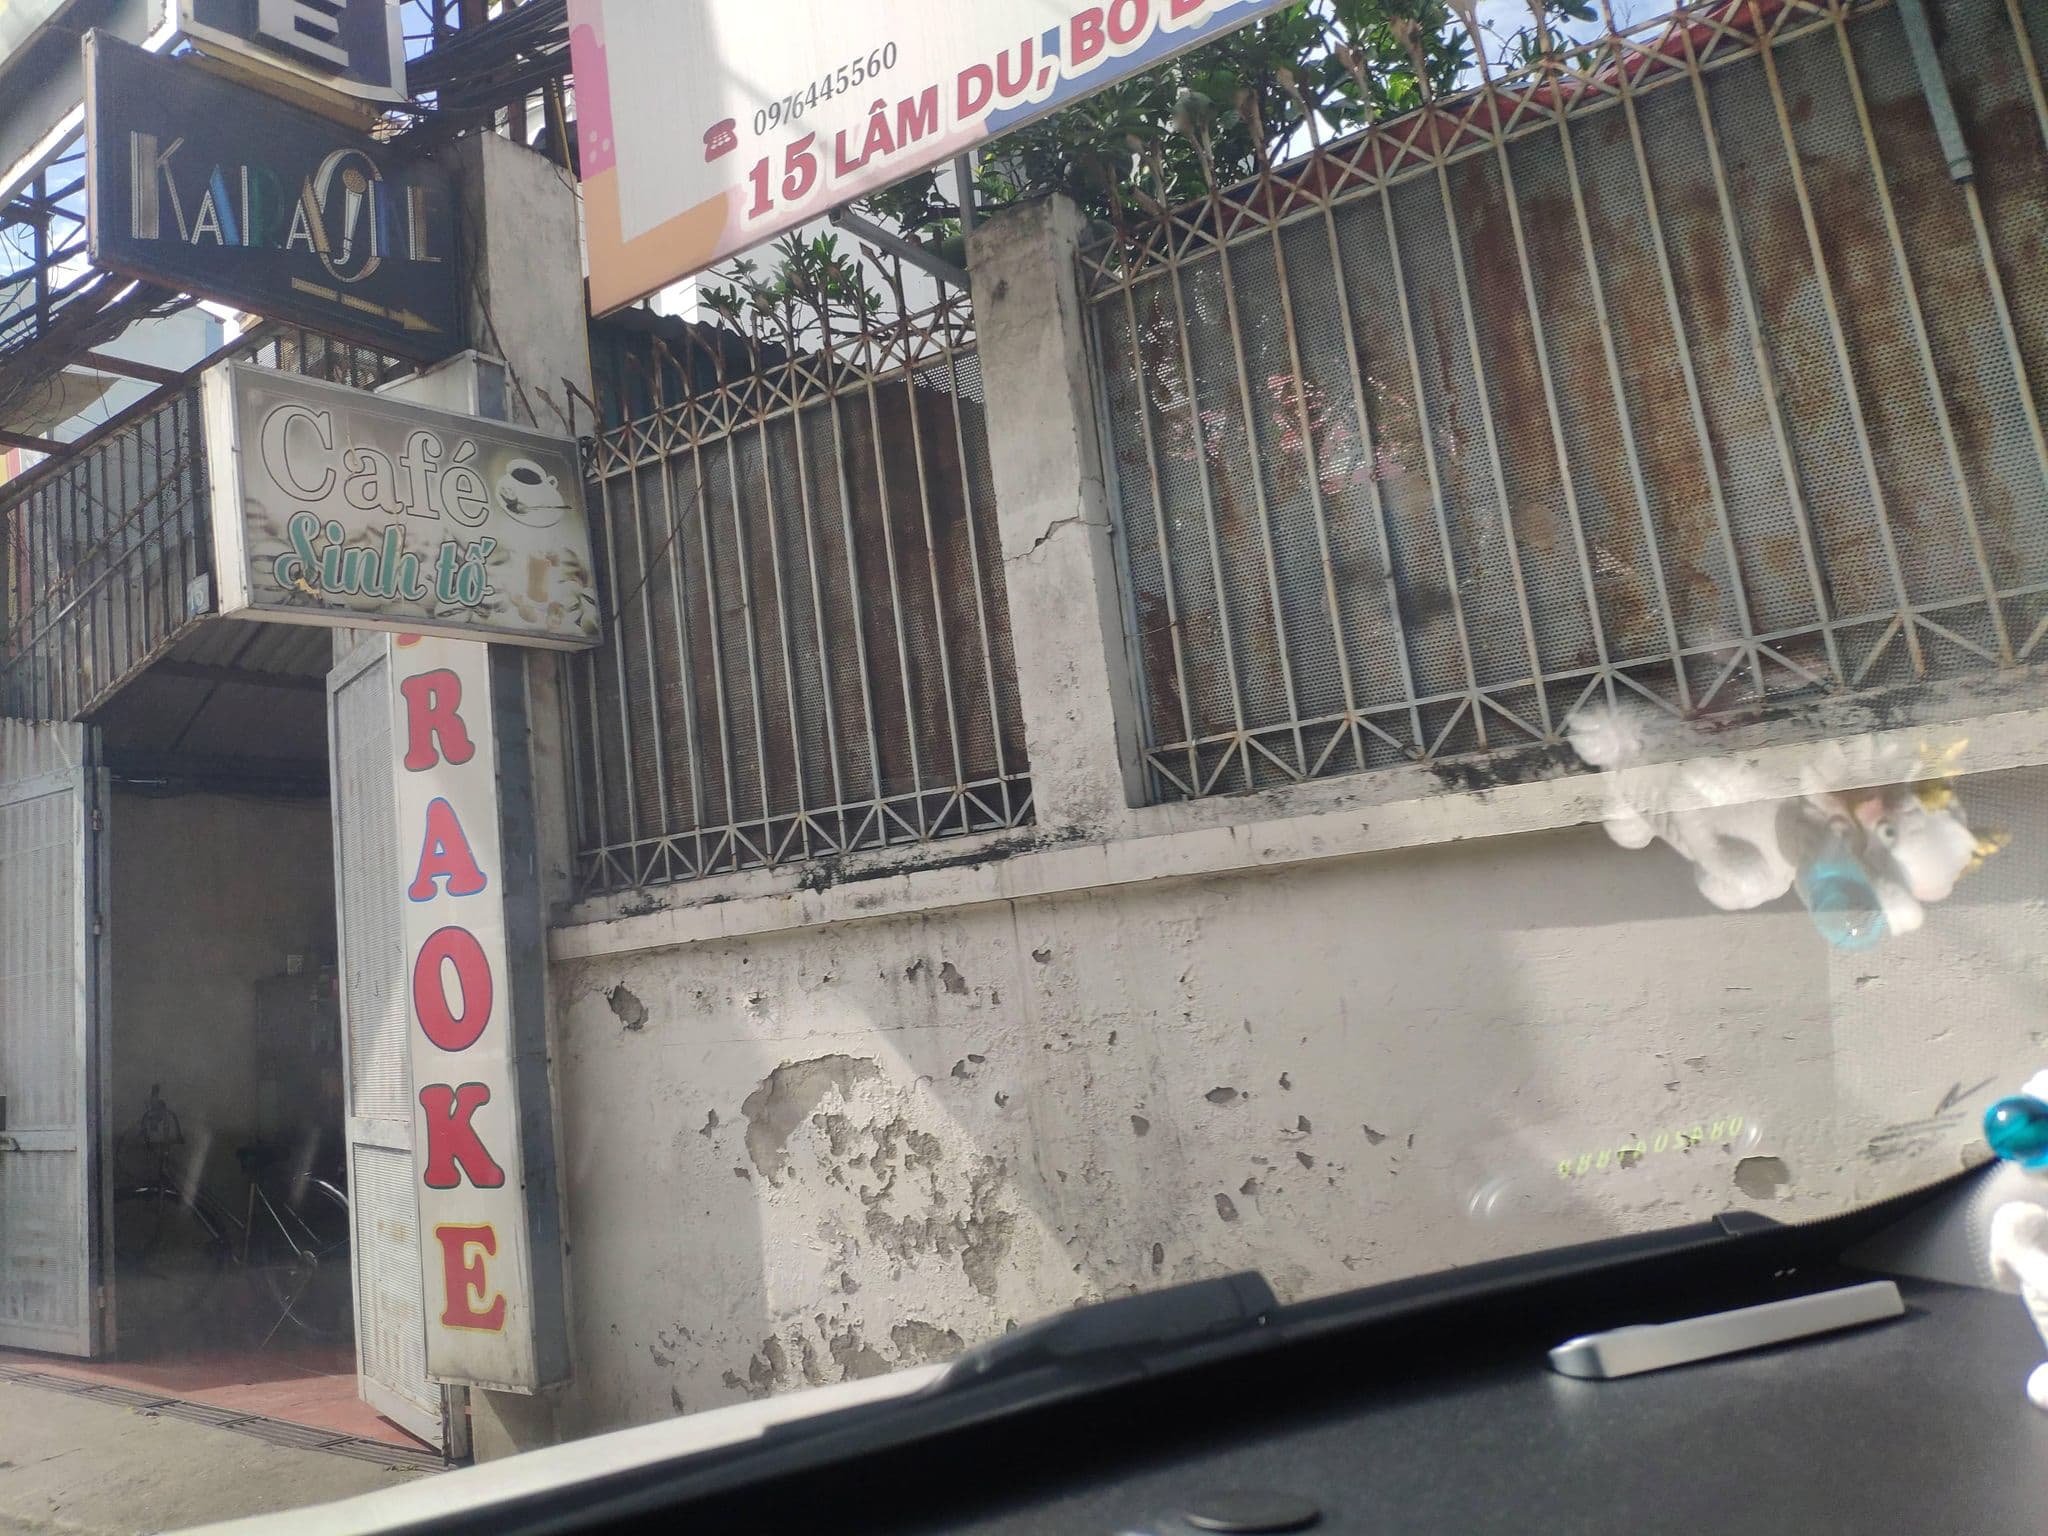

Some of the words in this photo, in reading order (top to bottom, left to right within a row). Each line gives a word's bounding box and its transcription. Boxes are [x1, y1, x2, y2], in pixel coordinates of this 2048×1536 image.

[748, 130, 818, 220] 15
[834, 85, 939, 179] LÂM
[957, 37, 1052, 121] DU,
[753, 41, 898, 136] 0976445560
[261, 404, 490, 528] Café
[273, 511, 428, 600] Sinh
[434, 537, 497, 607] tố
[396, 634, 509, 1334] RAOKE
